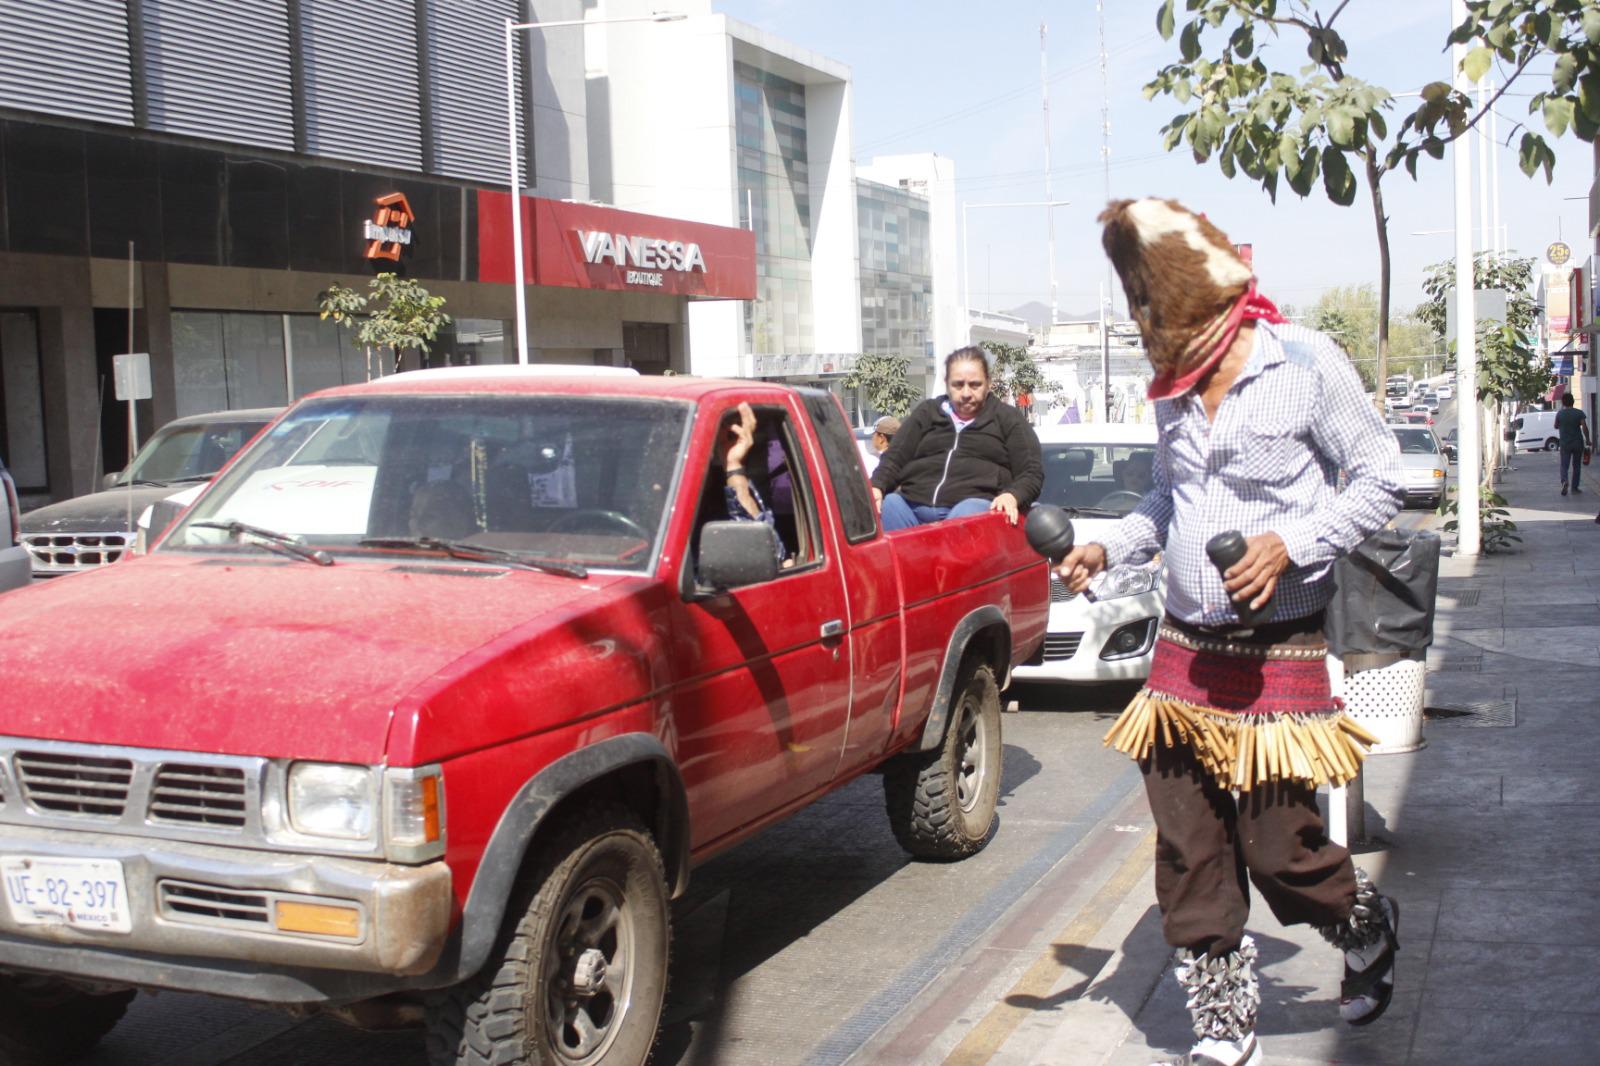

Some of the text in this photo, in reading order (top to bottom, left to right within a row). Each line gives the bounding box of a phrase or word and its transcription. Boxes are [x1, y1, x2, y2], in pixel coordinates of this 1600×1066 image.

[577, 230, 707, 273] VANESSA
[626, 270, 663, 287] BOUTIQUE
[7, 876, 118, 908] UE-82-397
